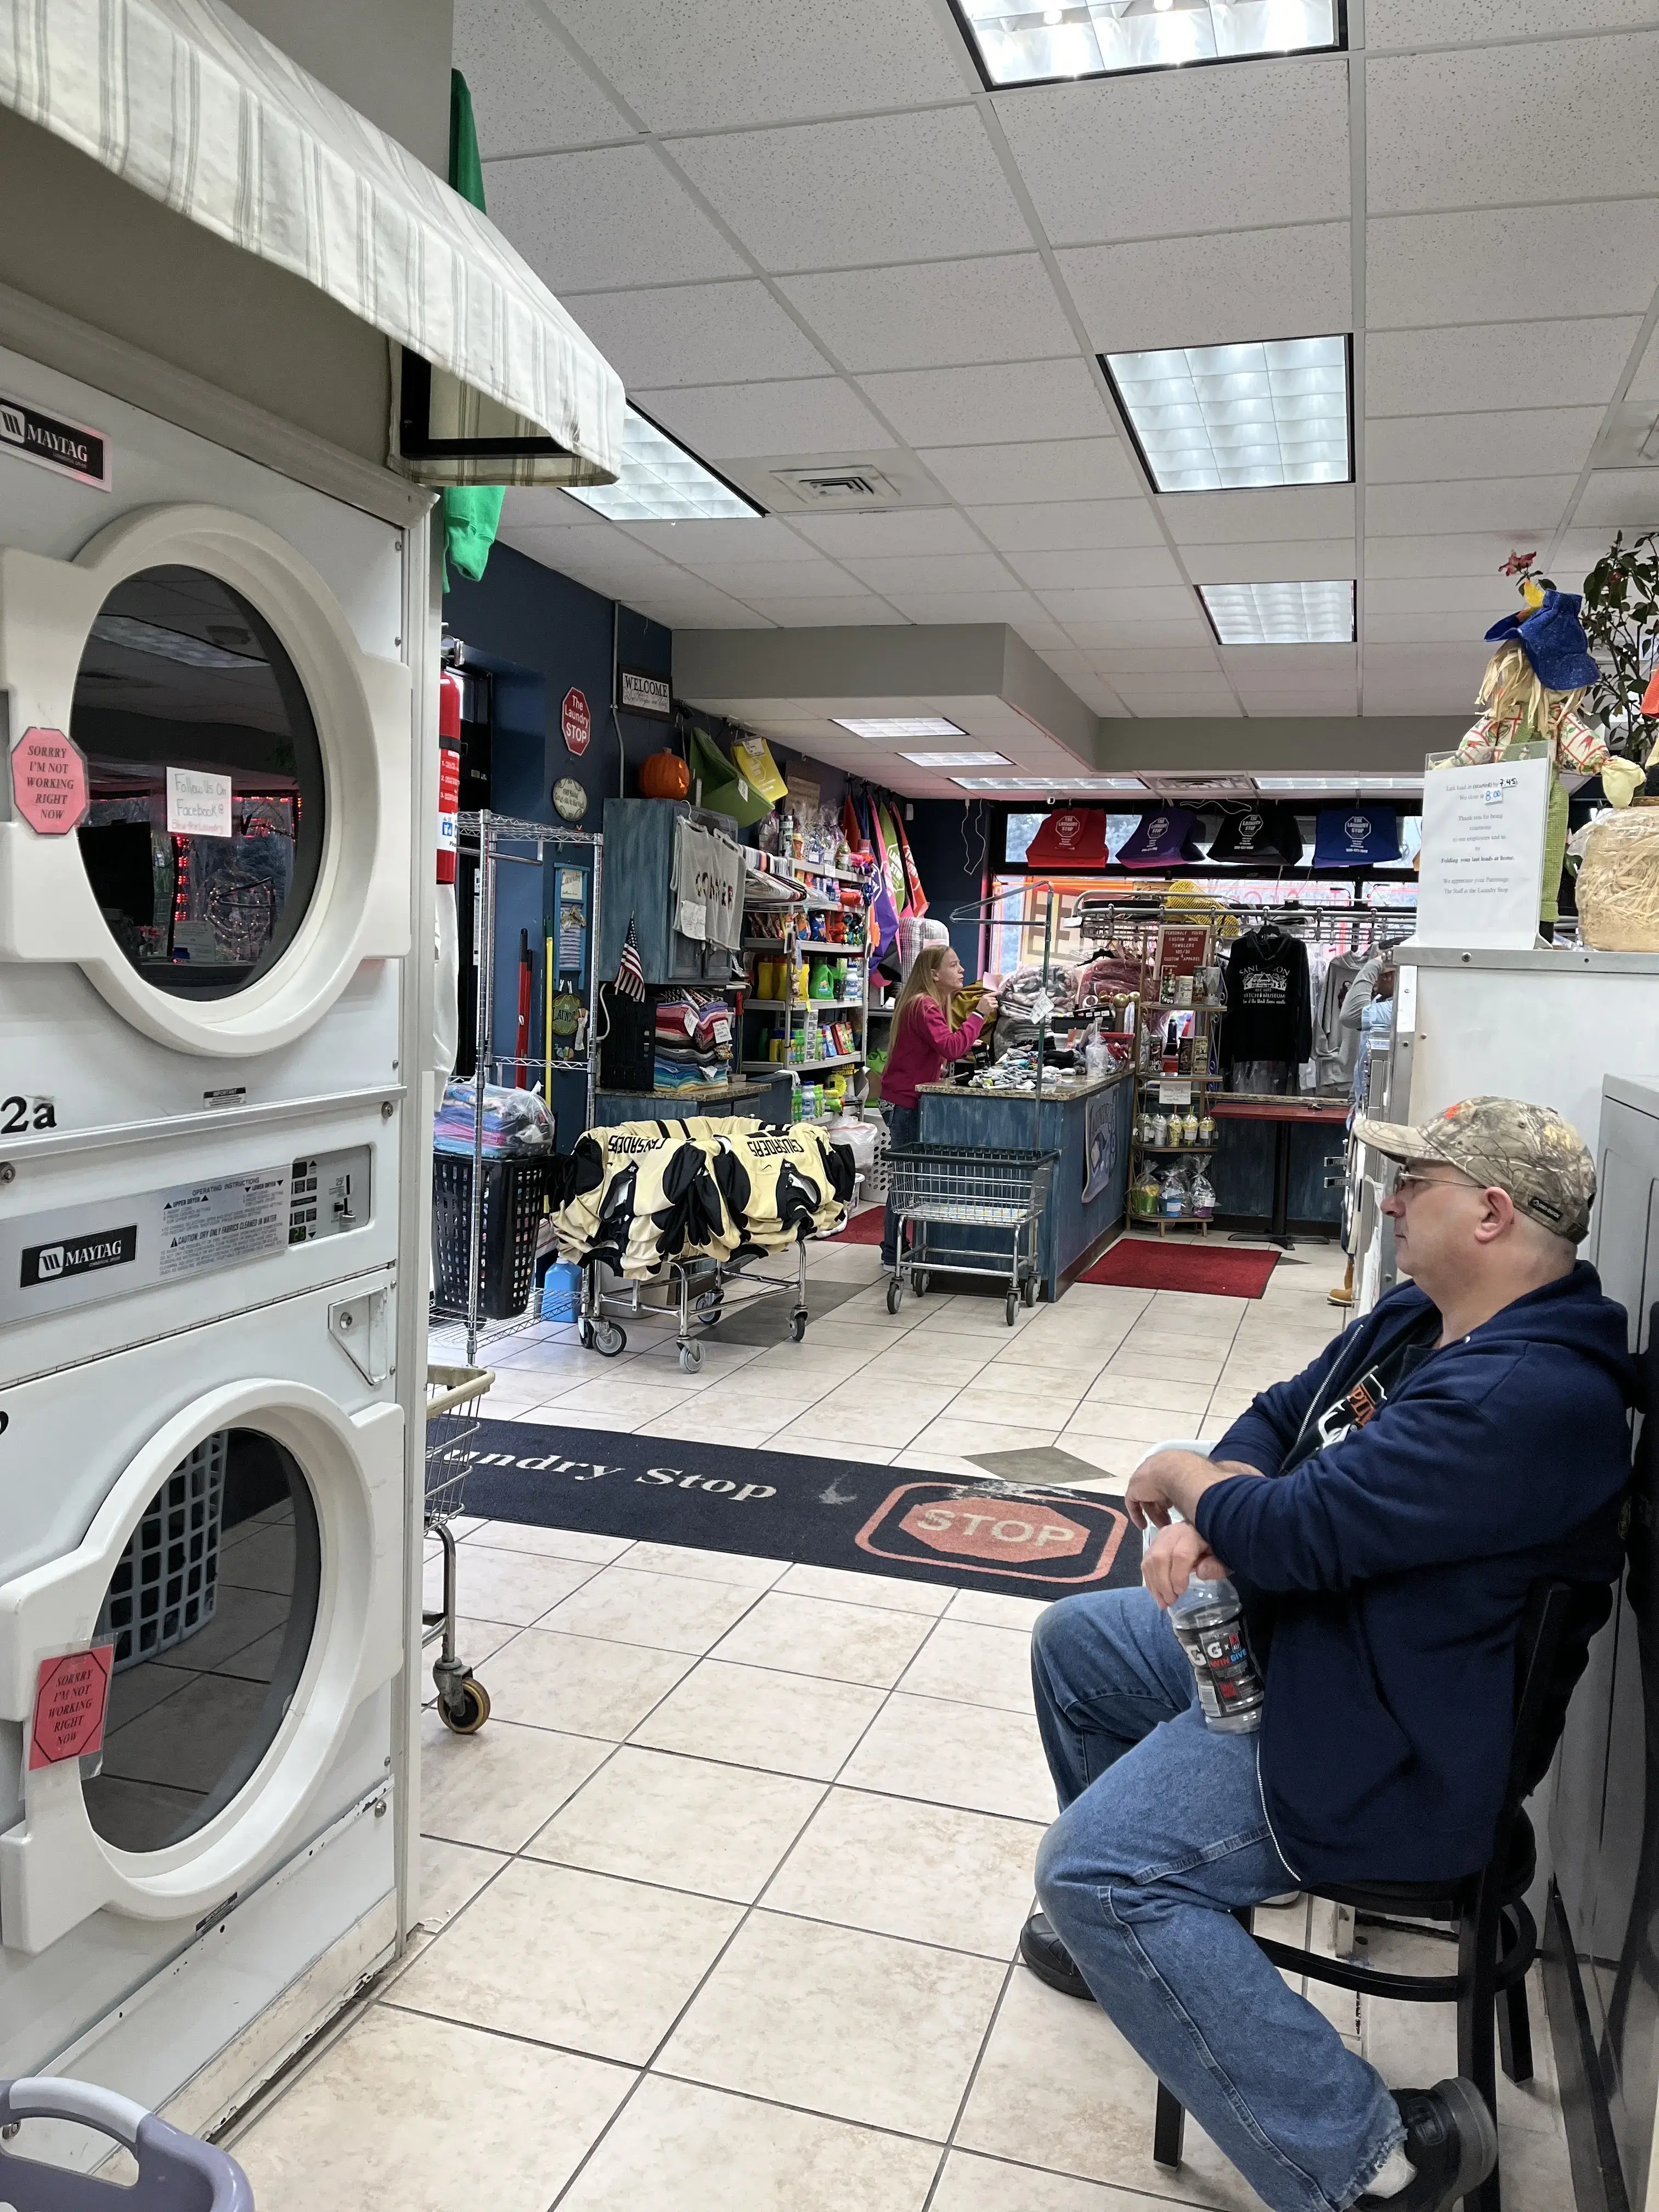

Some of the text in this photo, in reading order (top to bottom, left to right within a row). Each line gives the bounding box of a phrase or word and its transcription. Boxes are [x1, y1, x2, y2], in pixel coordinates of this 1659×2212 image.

[28, 424, 88, 462] MAYTAG
[624, 675, 668, 698] WELCOME
[572, 695, 583, 711] The
[565, 708, 589, 729] Laundry
[566, 722, 587, 744] STOP
[30, 761, 68, 774] I'M NOT
[27, 777, 74, 789] WORKING
[35, 794, 67, 804] RIGHT
[177, 799, 217, 817] Facebook
[41, 809, 64, 819] NOW
[1, 1096, 57, 1134] 2a
[747, 1139, 805, 1156] CRUSADERS
[192, 1177, 259, 1196] OPERATING INSTRUCTIONS
[173, 1199, 186, 1207] UPPER
[65, 1240, 122, 1267] MAYTAG
[635, 1468, 777, 1501] Stop
[917, 1509, 1075, 1547] STOP
[1207, 1641, 1223, 1659] G
[1210, 1649, 1247, 1667] WIN GIVE
[54, 1684, 92, 1703] I'M NOT
[48, 1698, 93, 1718] WORKING
[54, 1715, 84, 1733] RIGHT
[57, 1730, 79, 1746] NOW
